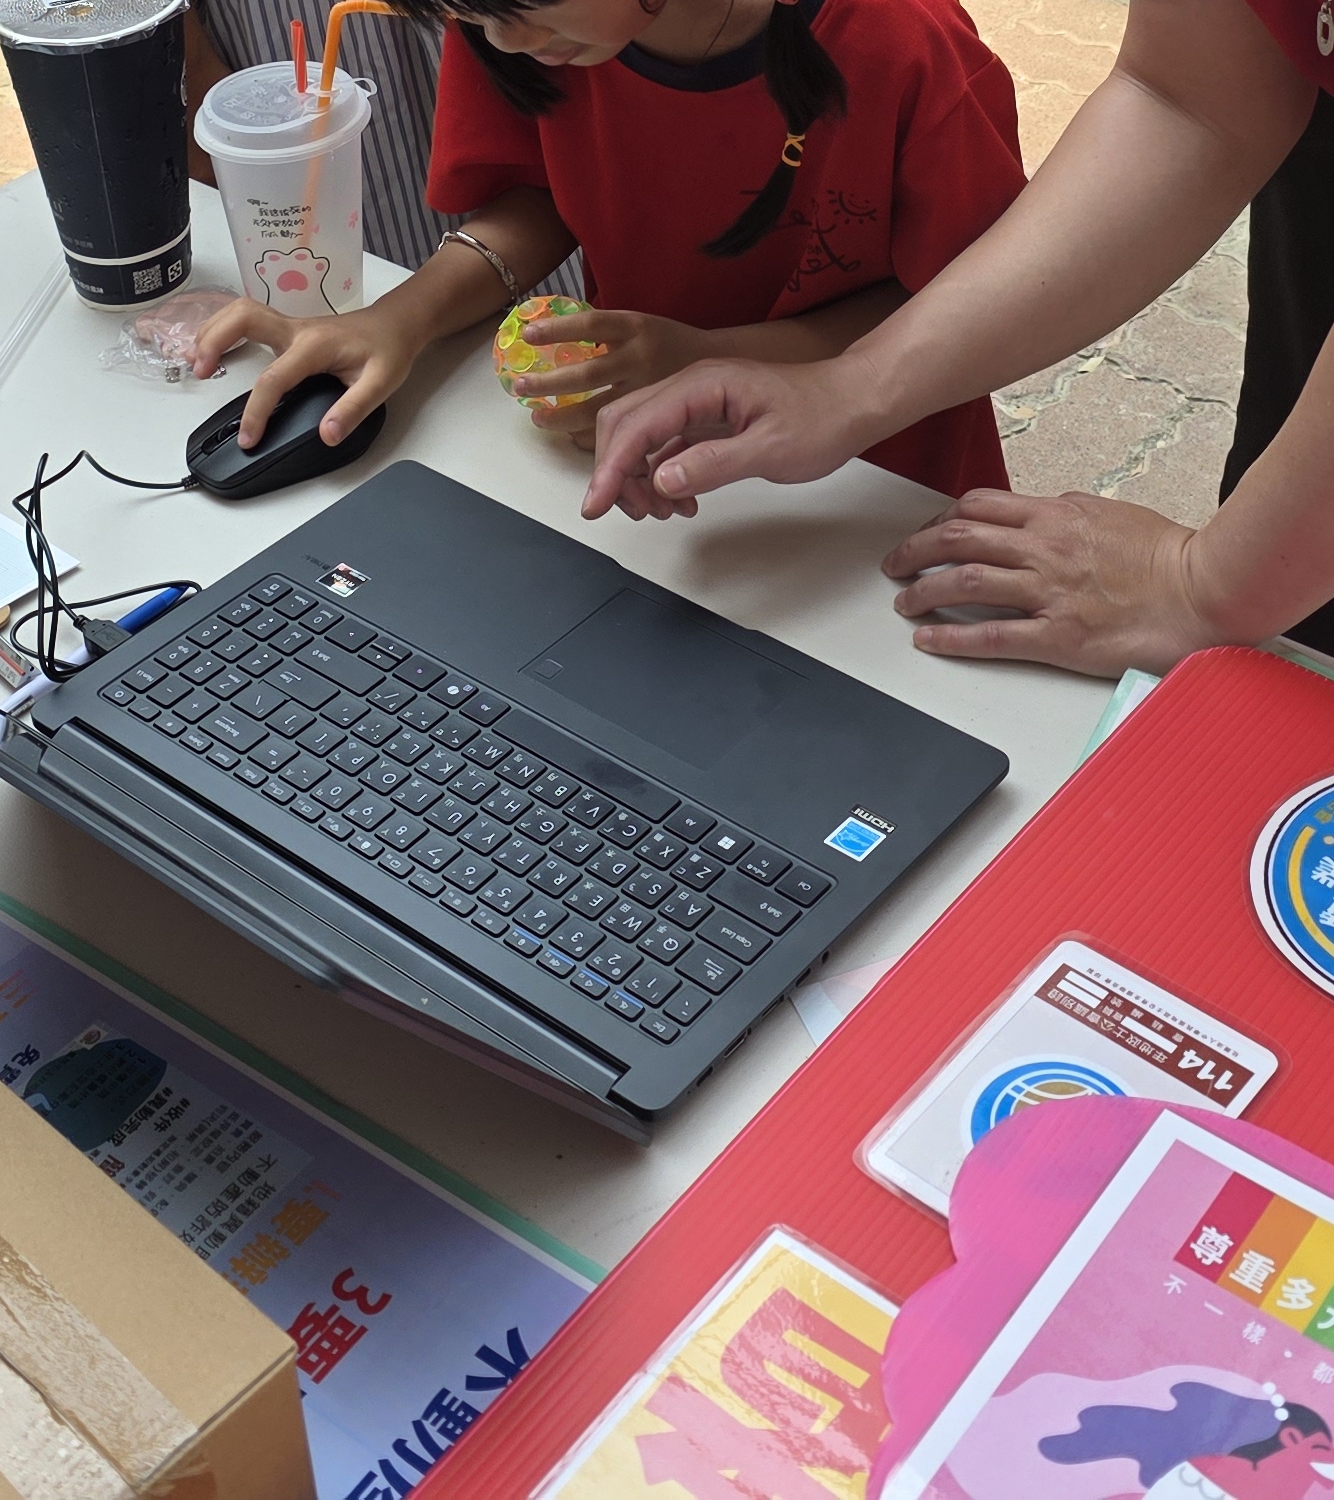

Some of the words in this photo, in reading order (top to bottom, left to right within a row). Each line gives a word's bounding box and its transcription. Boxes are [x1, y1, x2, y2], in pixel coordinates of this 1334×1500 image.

[410, 744, 420, 754] L
[484, 745, 502, 758] M
[351, 756, 364, 764] P
[439, 763, 454, 773] K
[518, 766, 534, 777] N
[471, 782, 485, 790] J
[554, 786, 567, 796] B
[362, 807, 373, 815] 9
[504, 800, 520, 812] H
[586, 806, 600, 817] V
[448, 812, 462, 824] U
[396, 826, 407, 835] 8
[540, 821, 554, 831] G
[622, 825, 637, 836] C
[482, 833, 495, 844] Y
[427, 848, 443, 856] 7
[575, 842, 589, 852] F
[659, 845, 674, 857] X
[517, 853, 530, 865] T
[464, 867, 476, 875] 6
[613, 864, 626, 874] D
[696, 866, 714, 879] Z
[553, 873, 567, 885] R
[497, 888, 511, 897] 5
[649, 883, 662, 894] S
[589, 894, 603, 907] E
[534, 910, 547, 918] 4
[688, 904, 701, 915] A
[626, 916, 642, 932] W
[571, 932, 583, 942] 3
[736, 935, 751, 947] Caps
[663, 938, 678, 950] Q
[608, 954, 621, 964] 2
[1176, 1046, 1239, 1094] 114
[218, 1180, 339, 1296] 1.要辦
